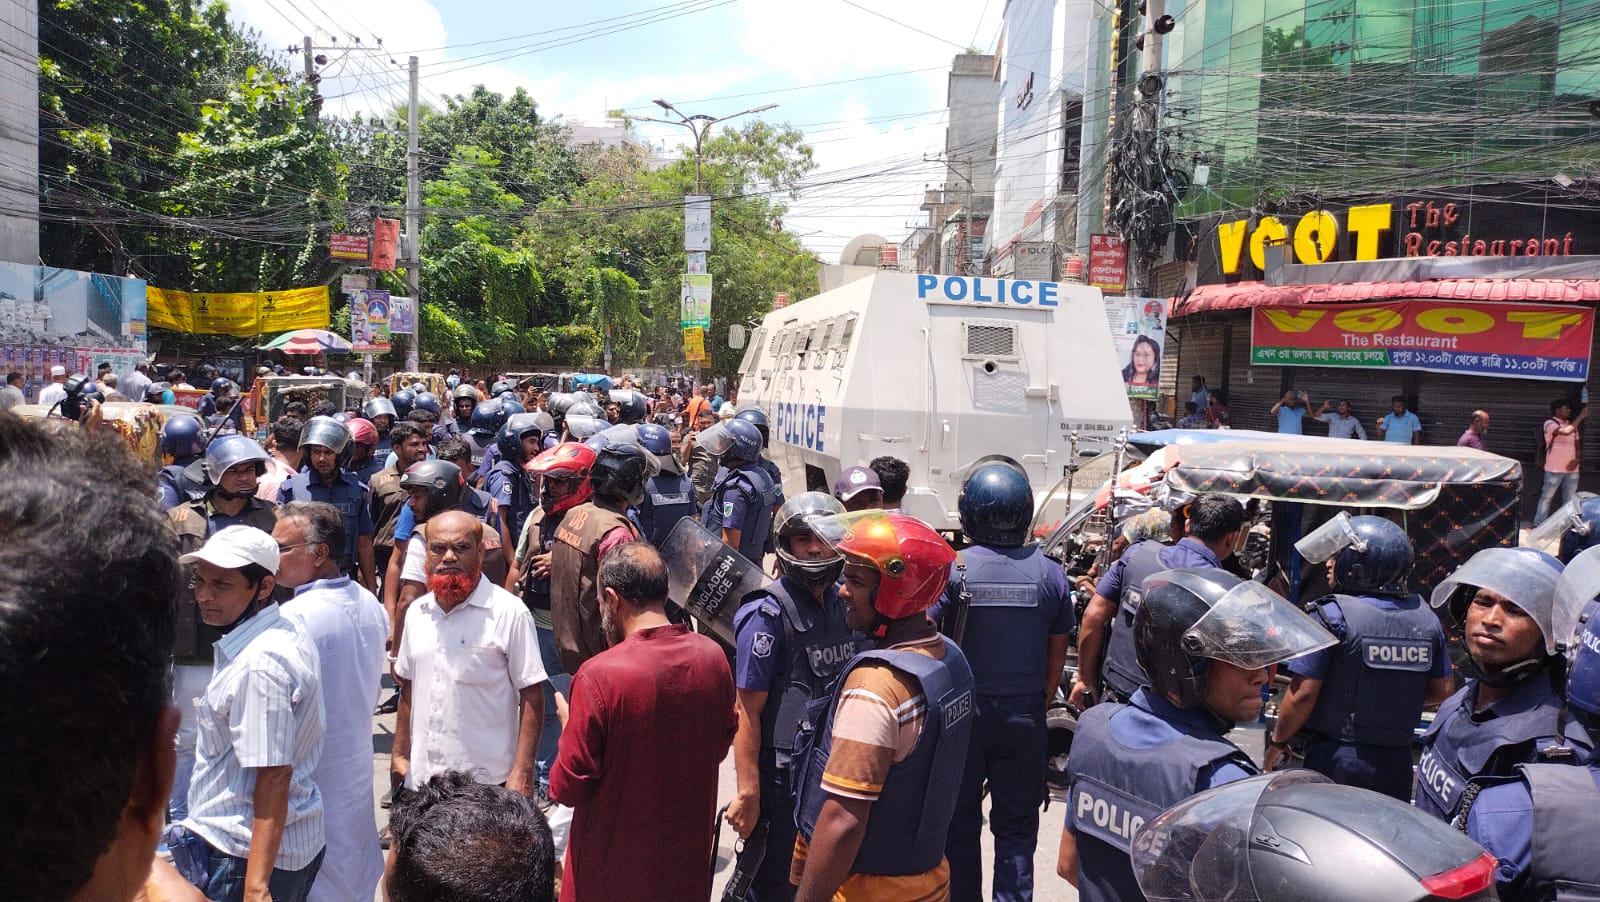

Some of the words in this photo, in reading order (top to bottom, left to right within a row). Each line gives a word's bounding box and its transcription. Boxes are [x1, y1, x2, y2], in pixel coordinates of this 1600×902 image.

[1407, 201, 1458, 228] The
[1218, 204, 1393, 273] VOOT
[1405, 232, 1572, 257] Restaurant
[918, 274, 1058, 306] POLICE
[1264, 308, 1582, 339] VOOT
[1342, 334, 1368, 346] The
[1373, 334, 1458, 349] Restaurant
[1256, 349, 1276, 359] এখন
[1292, 350, 1313, 360] তলায়
[1314, 350, 1328, 361] মহা
[1363, 351, 1385, 362] চলছে
[1393, 350, 1413, 365] দুপুর
[1415, 350, 1453, 365] ১২.০০টা
[1454, 354, 1479, 367] থেকে
[1481, 354, 1503, 369] রাত্রি
[1504, 356, 1548, 371] ১১.০০টা
[776, 402, 826, 452] POLICE
[568, 510, 588, 530] DB
[706, 578, 733, 614] POLICE
[975, 588, 1022, 599] POLICE
[812, 641, 856, 668] POLICE
[1368, 645, 1429, 663] POLICE
[947, 696, 970, 722] POLICE
